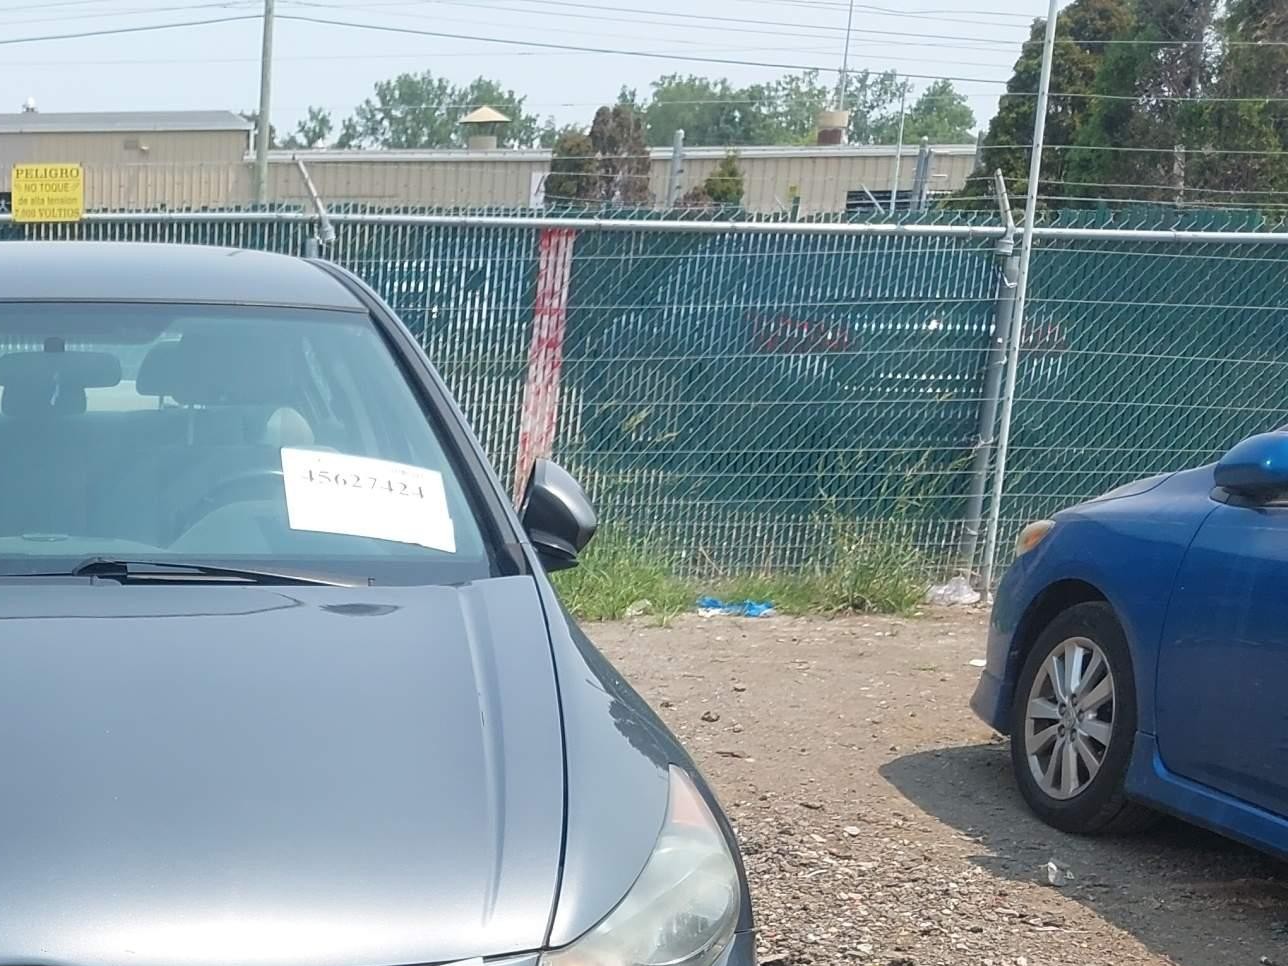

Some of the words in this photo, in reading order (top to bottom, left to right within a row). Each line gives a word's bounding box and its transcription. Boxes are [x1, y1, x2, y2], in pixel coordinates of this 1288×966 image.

[15, 168, 80, 179] PELIGRO
[24, 183, 37, 193] NO
[40, 183, 70, 193] TOQUE
